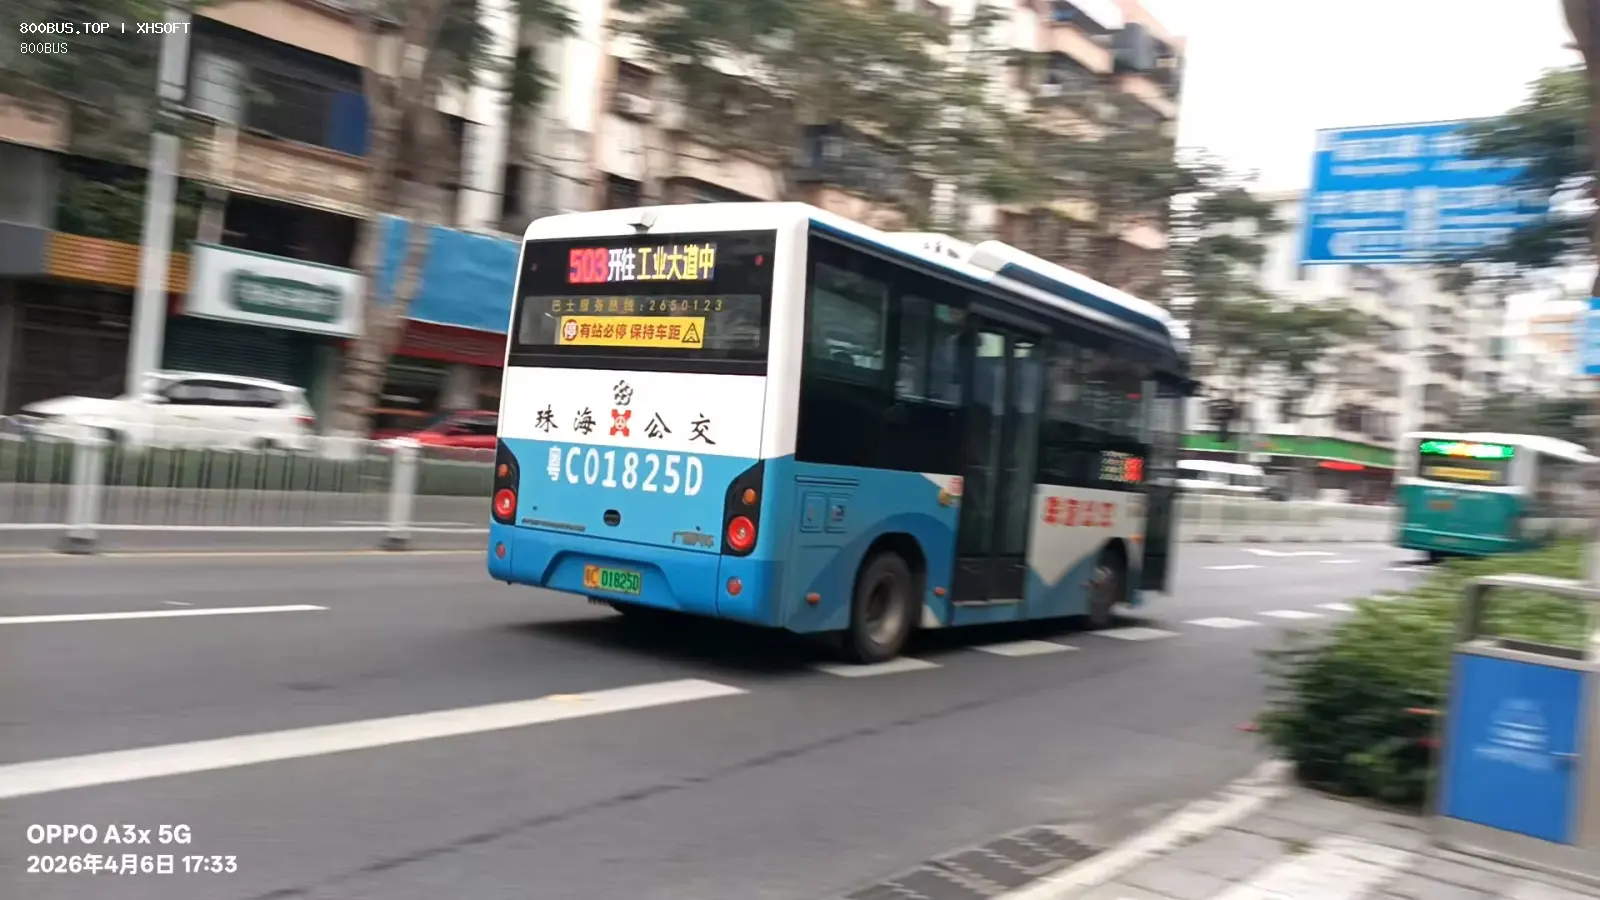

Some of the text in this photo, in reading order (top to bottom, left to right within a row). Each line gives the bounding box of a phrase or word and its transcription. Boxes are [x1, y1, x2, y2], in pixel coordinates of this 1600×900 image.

[568, 247, 608, 284] 503
[580, 323, 627, 340] 有站必停
[630, 324, 682, 341] 保持车距
[534, 404, 717, 446] 珠海 公交
[546, 445, 704, 497] 粤C01825D
